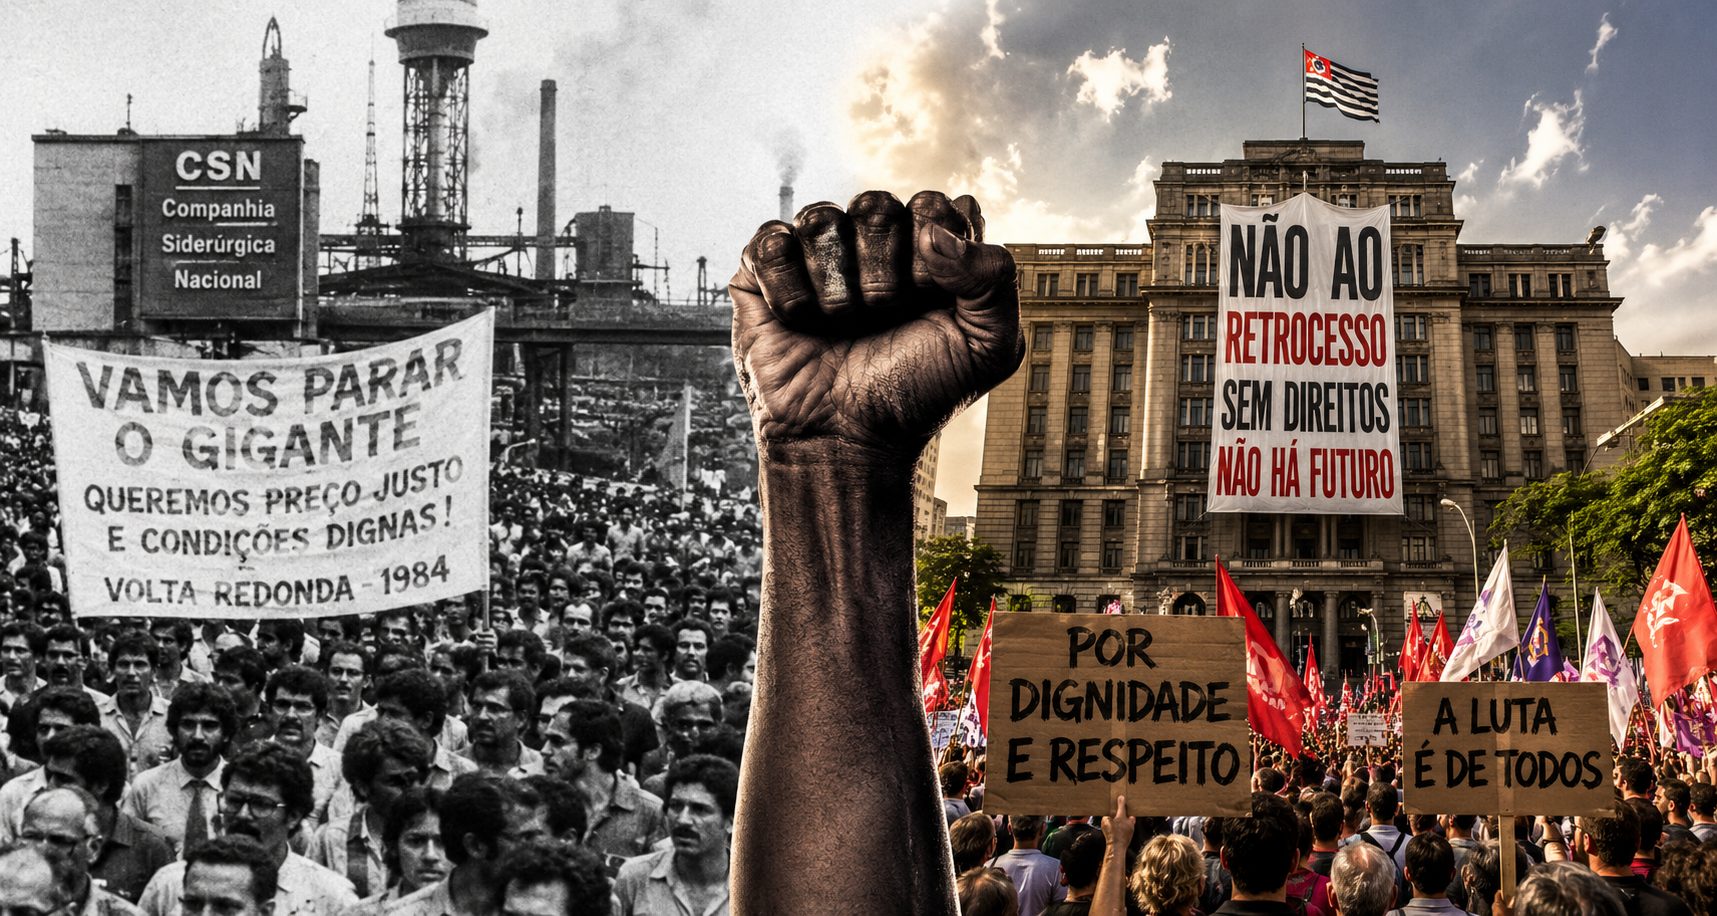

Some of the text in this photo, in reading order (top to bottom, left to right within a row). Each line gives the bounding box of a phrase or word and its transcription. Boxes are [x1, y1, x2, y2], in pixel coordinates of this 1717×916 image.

[176, 150, 262, 181] CSN
[162, 199, 276, 222] Companhia
[162, 233, 276, 257] Siderúrgica
[1229, 213, 1383, 301] NÃO AO
[174, 269, 262, 289] Nacional
[1225, 311, 1386, 367] RETROCESSO
[76, 337, 464, 417] VAMOS PARAR
[1221, 379, 1390, 433] SEM DIREITOS
[114, 402, 422, 471] O GIGANTE
[83, 454, 463, 517] QUEREMOS PREÇO JUSTO
[1216, 437, 1394, 499] NÃO HÁ FUTURO
[108, 526, 126, 552] E
[140, 521, 310, 563] CONDIÇÕES
[104, 576, 195, 604] VOLTA
[214, 574, 355, 607] REDONDA
[380, 554, 450, 595] 1984
[1066, 626, 1158, 669] POR
[1008, 678, 1231, 723] DIGNIDADE
[1433, 697, 1557, 735] A LUTA
[1006, 737, 1240, 786] E RESPEITO
[1414, 739, 1603, 789] É DE TODOS
